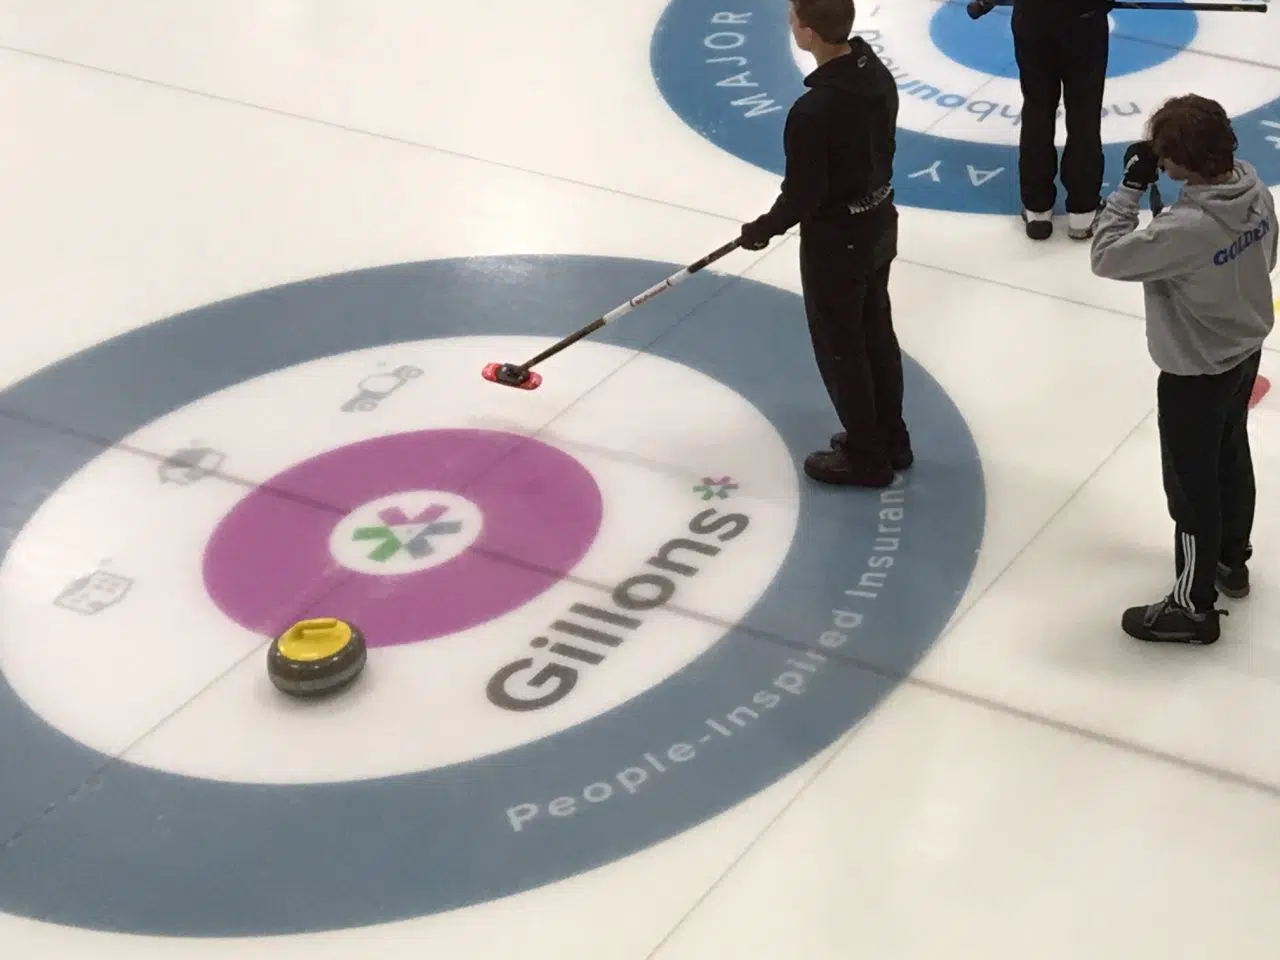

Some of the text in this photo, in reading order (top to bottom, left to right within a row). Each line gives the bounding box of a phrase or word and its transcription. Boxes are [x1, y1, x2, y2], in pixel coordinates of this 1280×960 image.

[704, 11, 783, 118] MAJOR
[485, 507, 750, 713] Gillons
[505, 489, 904, 833] People-Inspired Insuran
